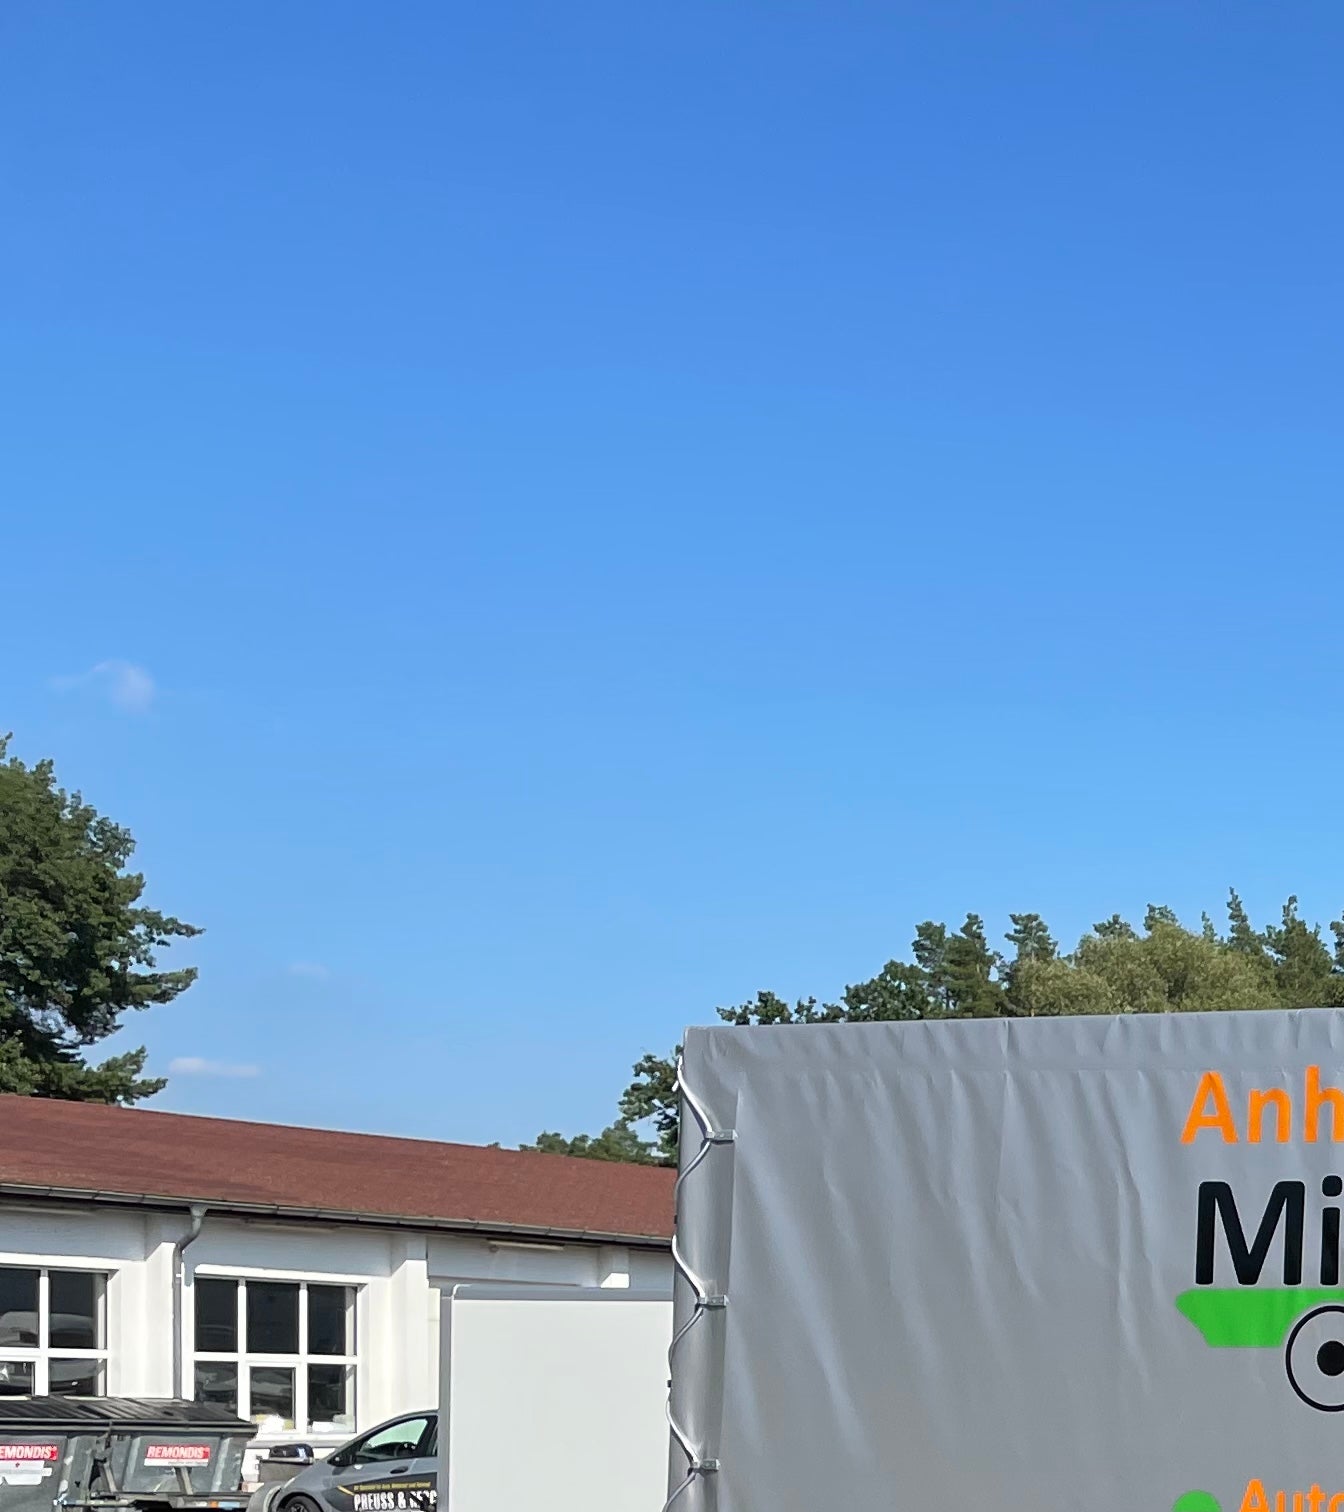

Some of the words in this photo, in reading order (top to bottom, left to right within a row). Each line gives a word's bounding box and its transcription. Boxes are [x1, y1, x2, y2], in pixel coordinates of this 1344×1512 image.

[0, 1446, 50, 1459] EMONDIS
[147, 1446, 204, 1458] REMONDIS
[354, 1492, 394, 1512] PREUSS
